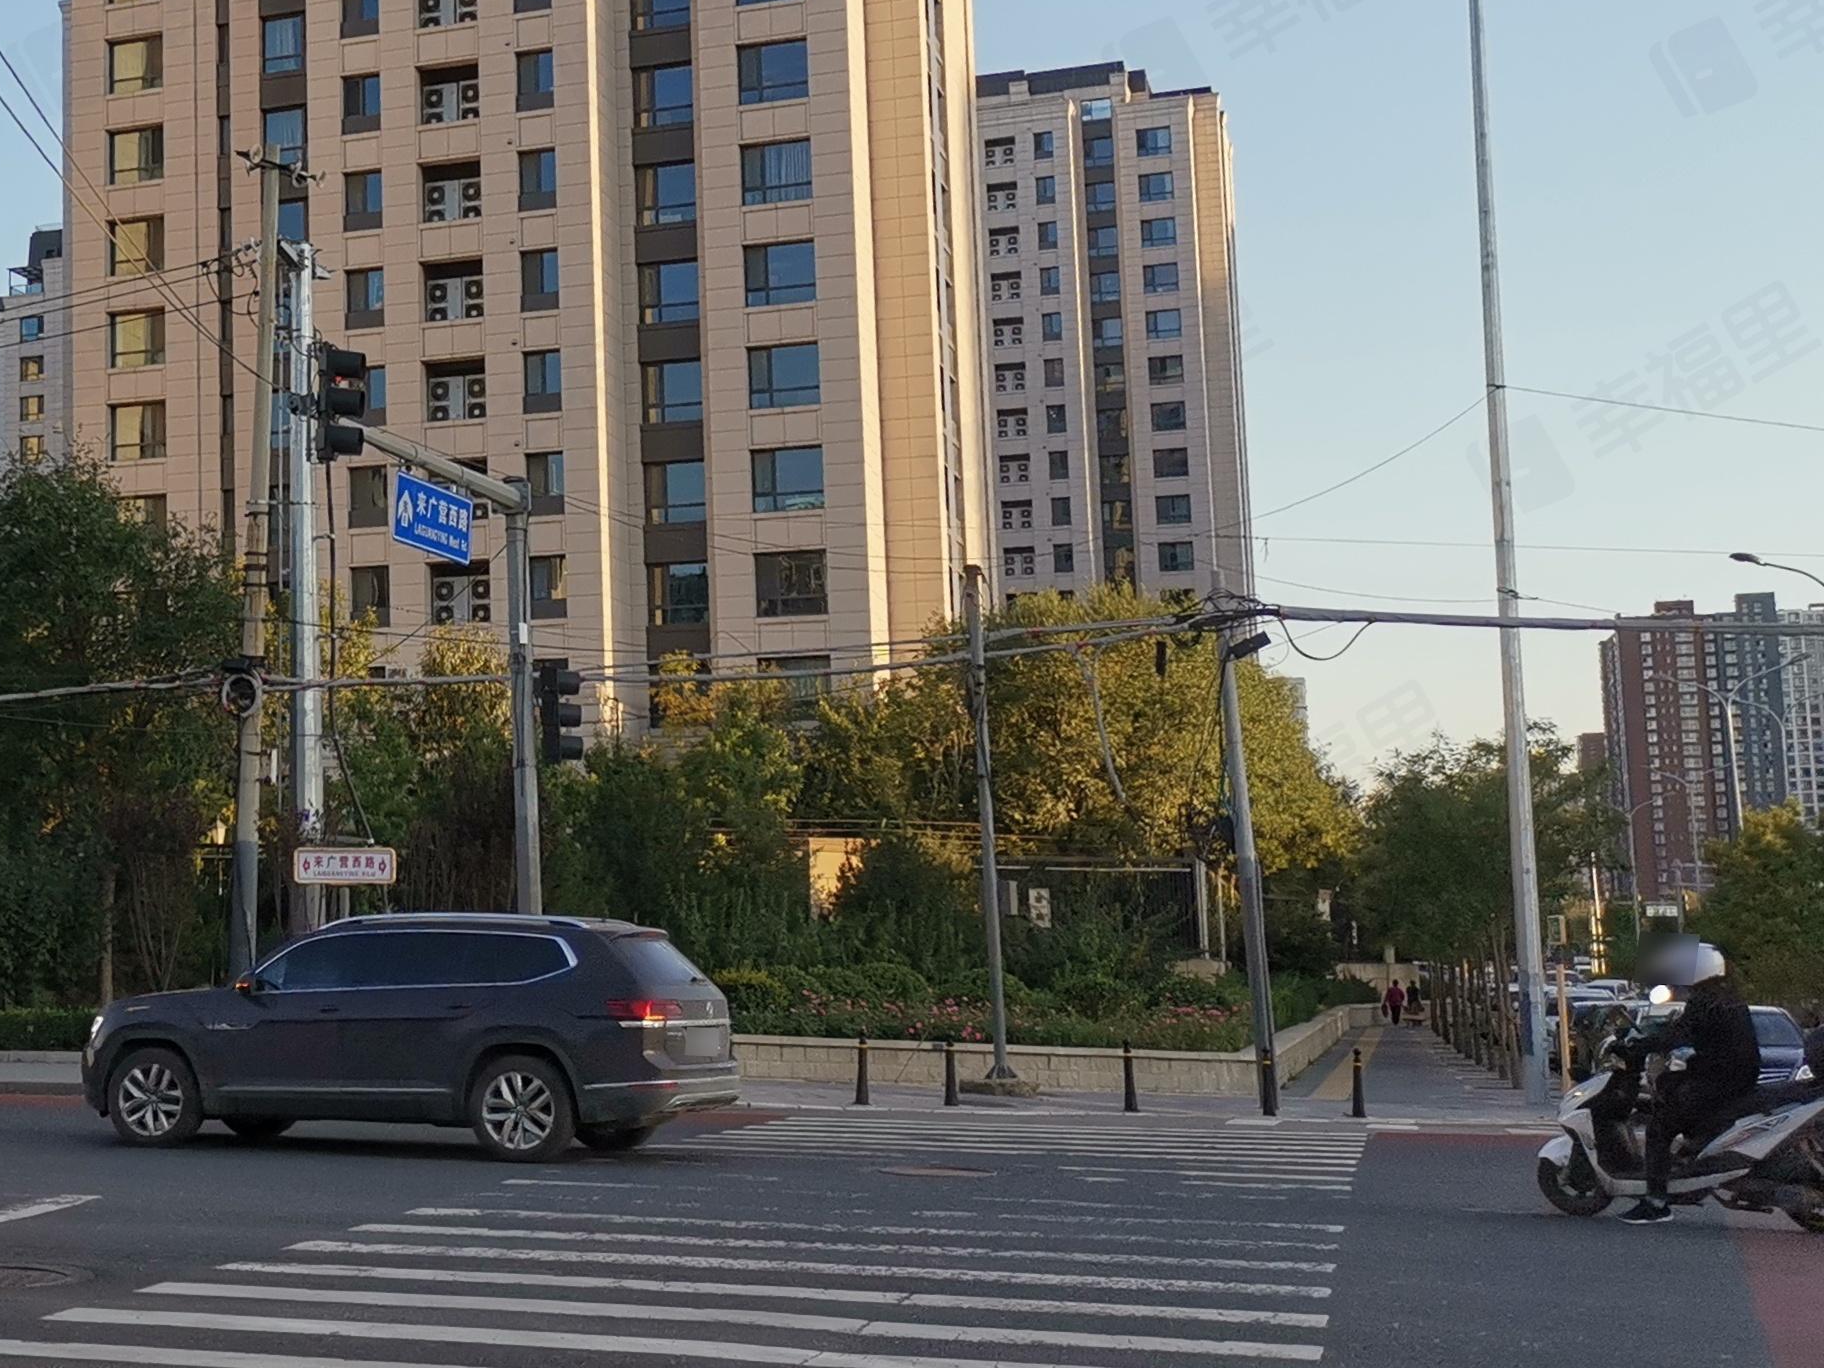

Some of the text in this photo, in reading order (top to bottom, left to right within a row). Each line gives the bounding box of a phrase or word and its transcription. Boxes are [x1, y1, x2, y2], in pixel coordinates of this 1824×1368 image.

[416, 491, 468, 533] 来广营西路
[314, 855, 375, 868] 来广营西路
